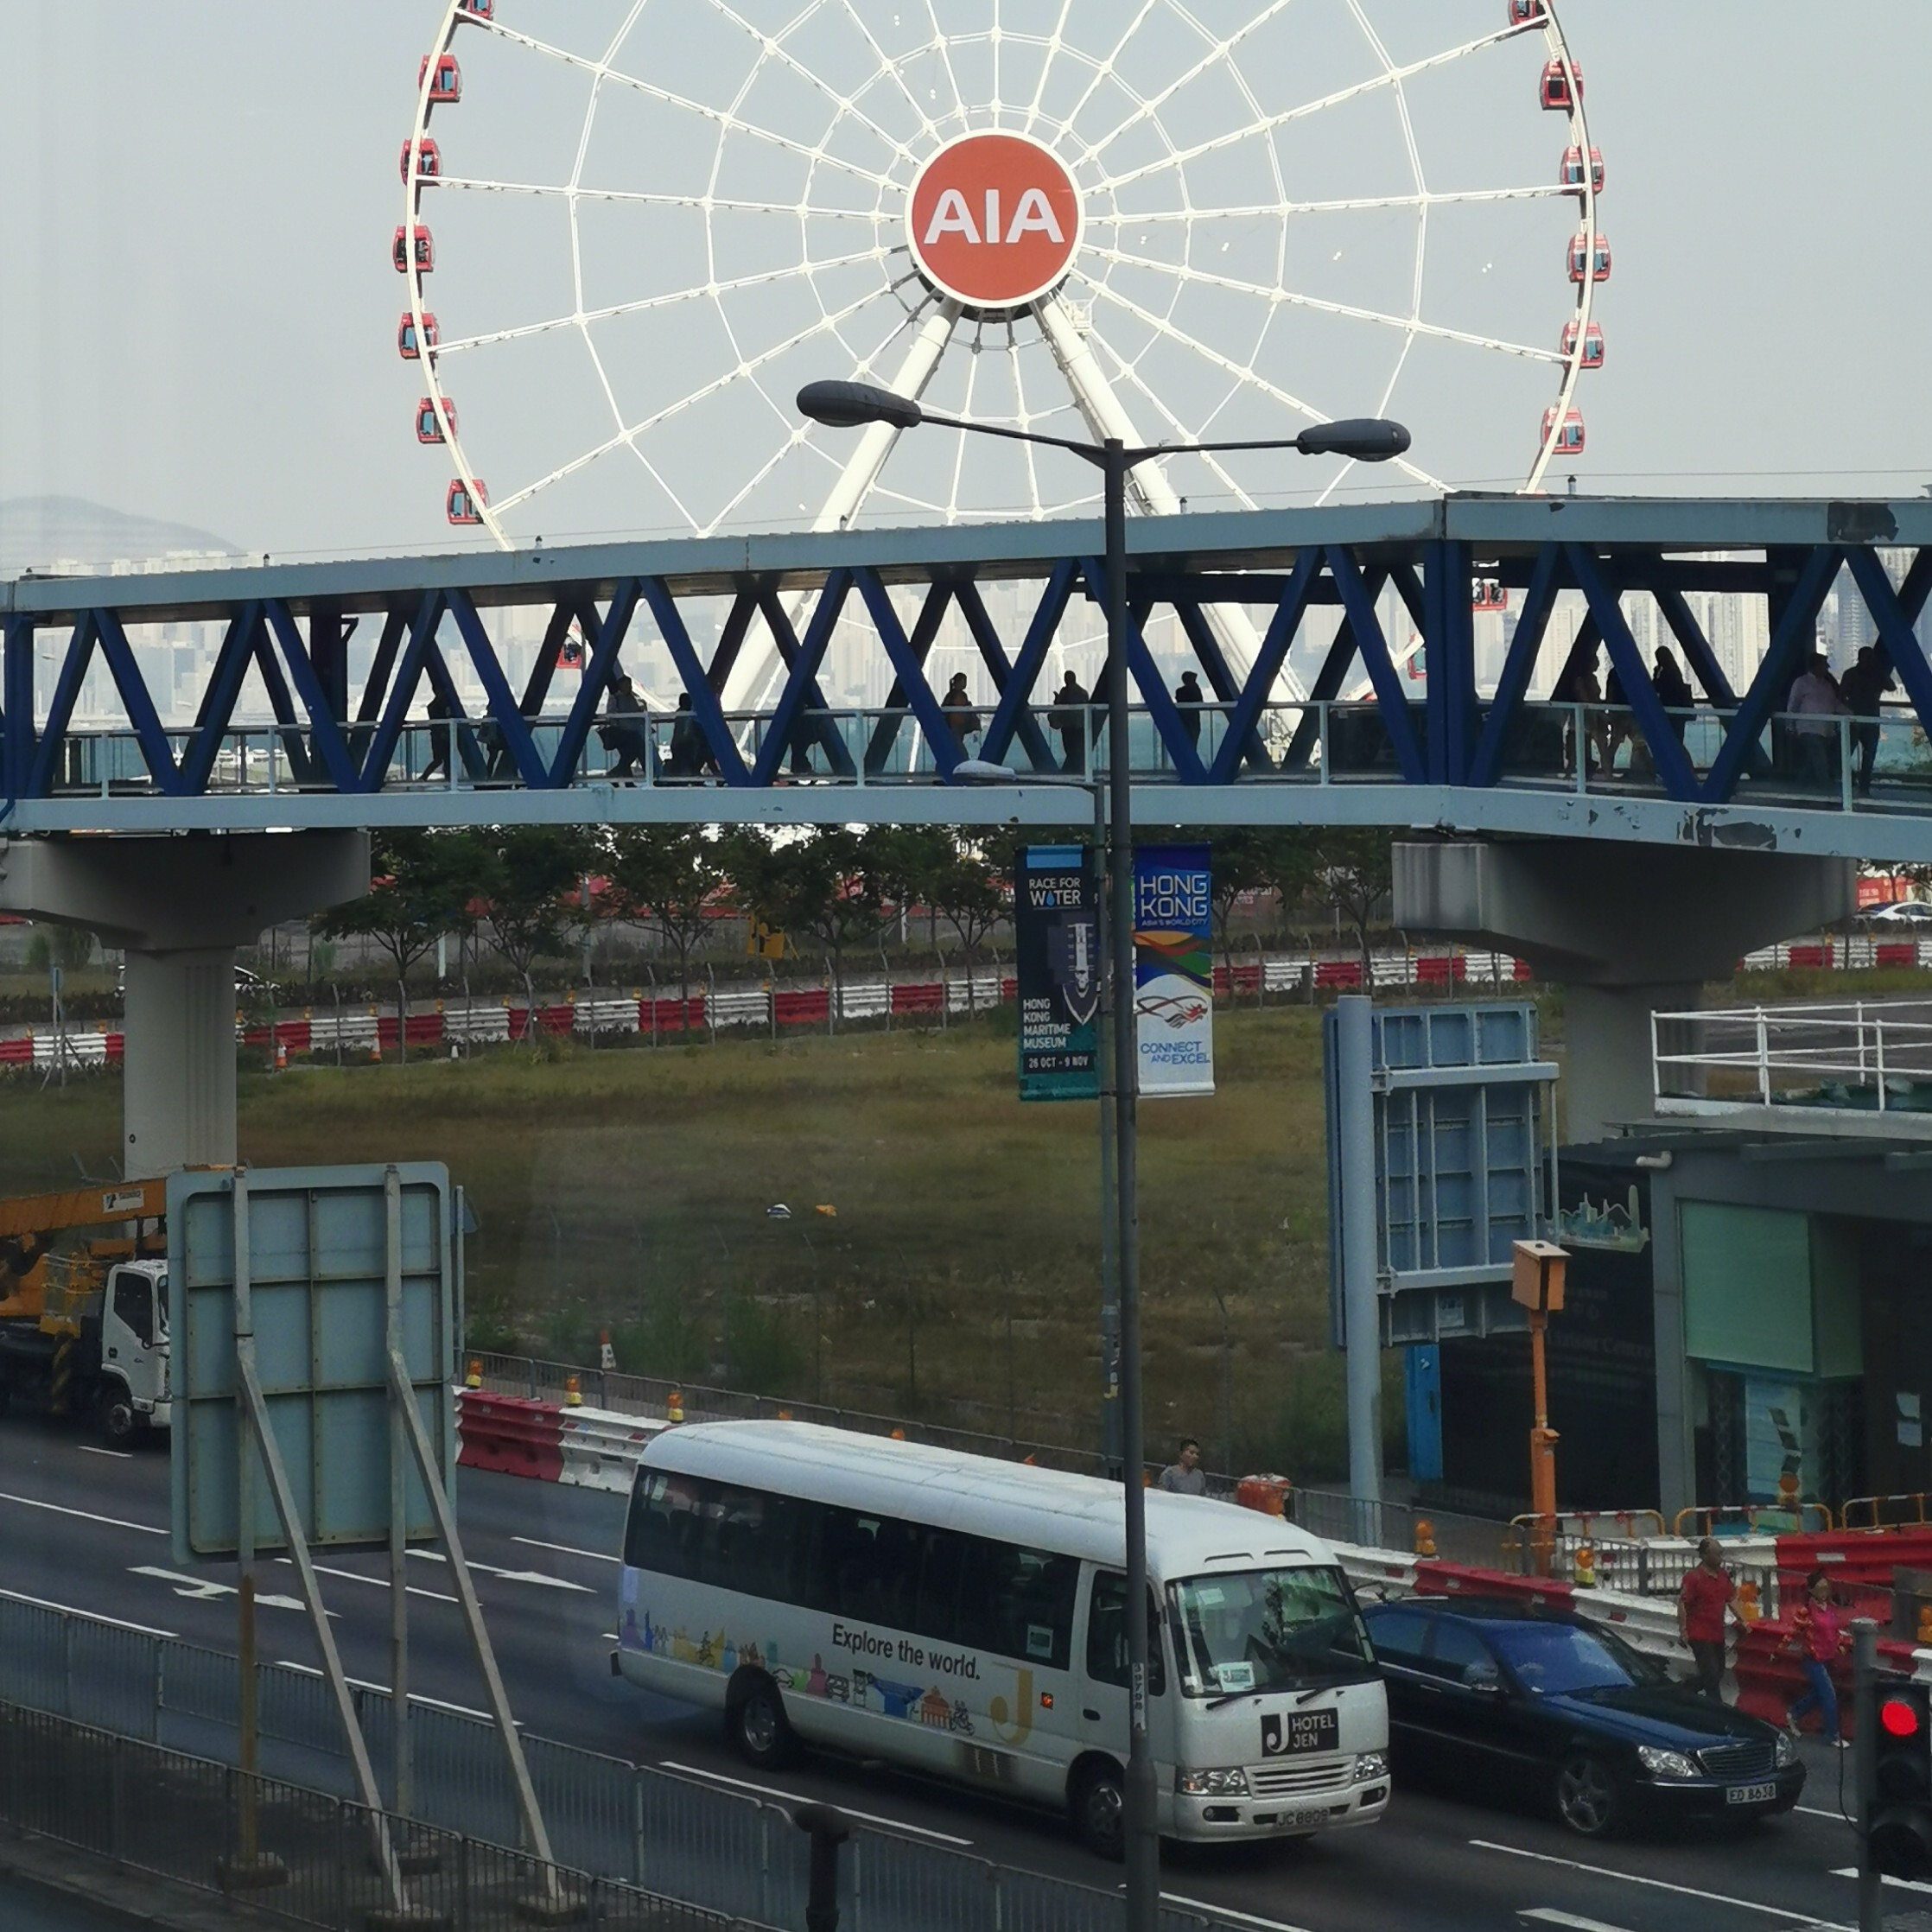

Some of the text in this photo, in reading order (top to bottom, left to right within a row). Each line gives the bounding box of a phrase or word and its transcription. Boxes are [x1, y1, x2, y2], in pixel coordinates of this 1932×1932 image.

[923, 187, 1065, 244] AIA
[1029, 877, 1081, 890] RACE FOR
[1141, 874, 1207, 895] HONG
[1141, 896, 1207, 918] KONG
[1023, 998, 1051, 1010] HONG
[1023, 1011, 1051, 1024] KONG
[1024, 1023, 1071, 1036] MARITIME
[1024, 1036, 1066, 1049] MUSEUM
[1141, 1041, 1203, 1054] CONNECT
[1040, 1057, 1056, 1068] OCT
[1151, 1052, 1211, 1065] AND EXCEL
[832, 1623, 981, 1681] Explore the world.
[1292, 1714, 1335, 1732] HOTEL
[1293, 1732, 1319, 1749] JEN
